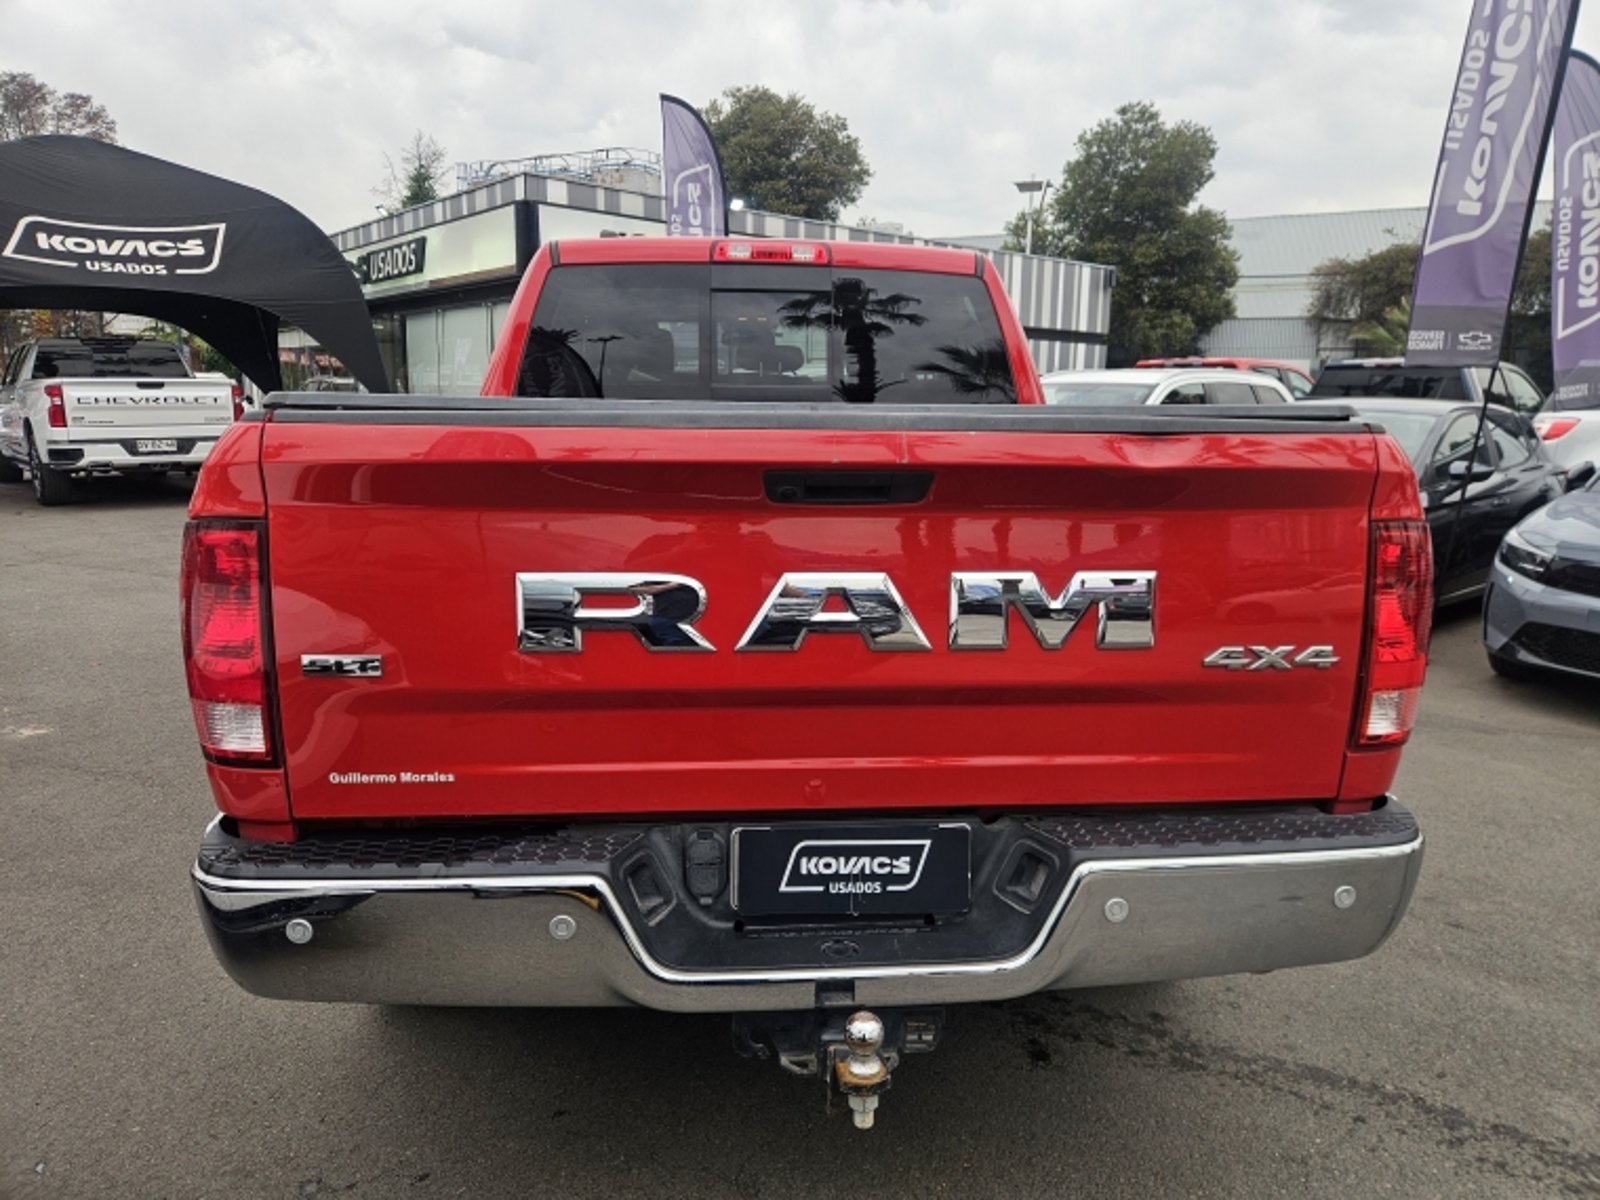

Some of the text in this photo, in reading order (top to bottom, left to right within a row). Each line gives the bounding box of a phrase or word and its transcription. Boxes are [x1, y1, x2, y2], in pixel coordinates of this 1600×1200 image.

[36, 231, 206, 257] KOVACS
[85, 260, 169, 276] USADOS
[368, 243, 417, 280] USADOS
[77, 396, 219, 405] CHEVROLET
[514, 571, 1158, 653] RAM
[329, 770, 456, 785] Guillermo Morales
[800, 856, 911, 875] KOVACS
[829, 881, 882, 894] USADOS
